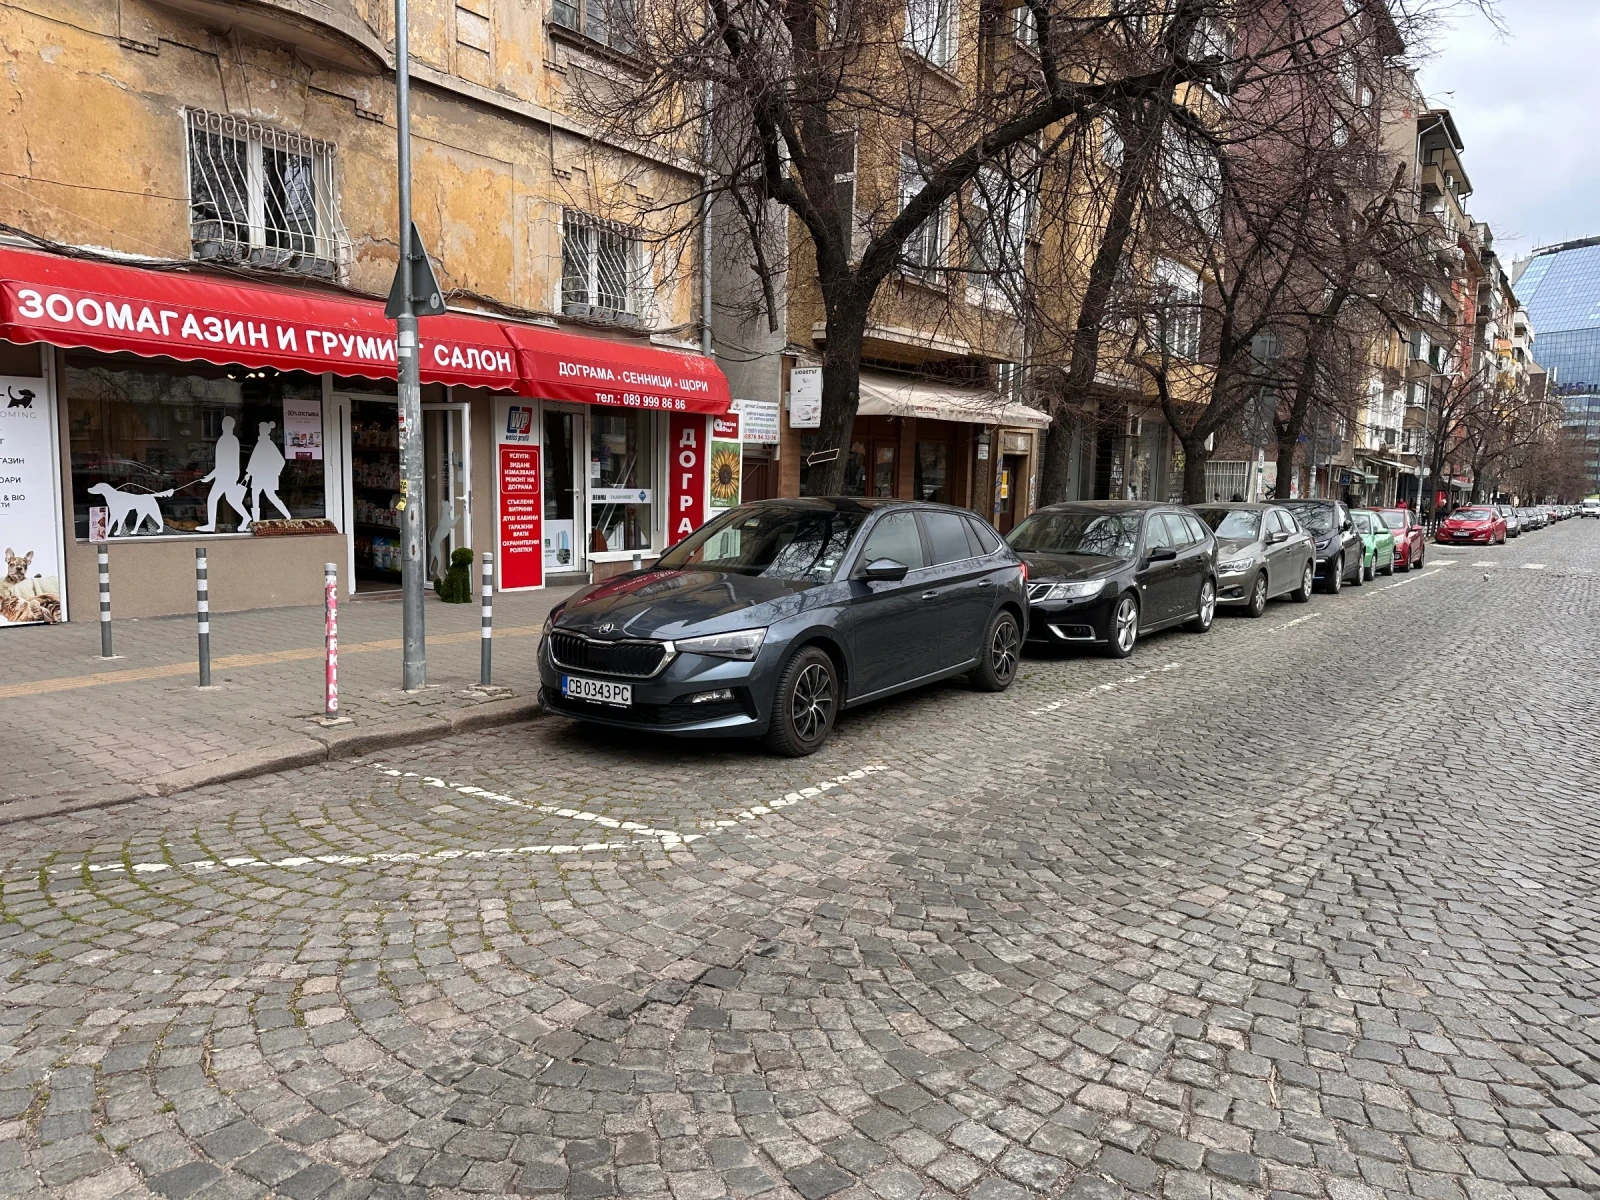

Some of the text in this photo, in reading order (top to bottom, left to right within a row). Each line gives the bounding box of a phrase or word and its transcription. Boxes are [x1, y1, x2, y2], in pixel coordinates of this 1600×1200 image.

[18, 289, 512, 373] ЗООМАГАЗИН И ГРУМИ САЛОН
[558, 362, 709, 392] ДОГРАМА СЕННИЦИ ЩОРИ
[595, 393, 686, 410] тел.: 089 999 86 86
[510, 411, 530, 430] WP
[677, 428, 697, 542] ДОГРА
[569, 679, 630, 702] CB 0343 PC
